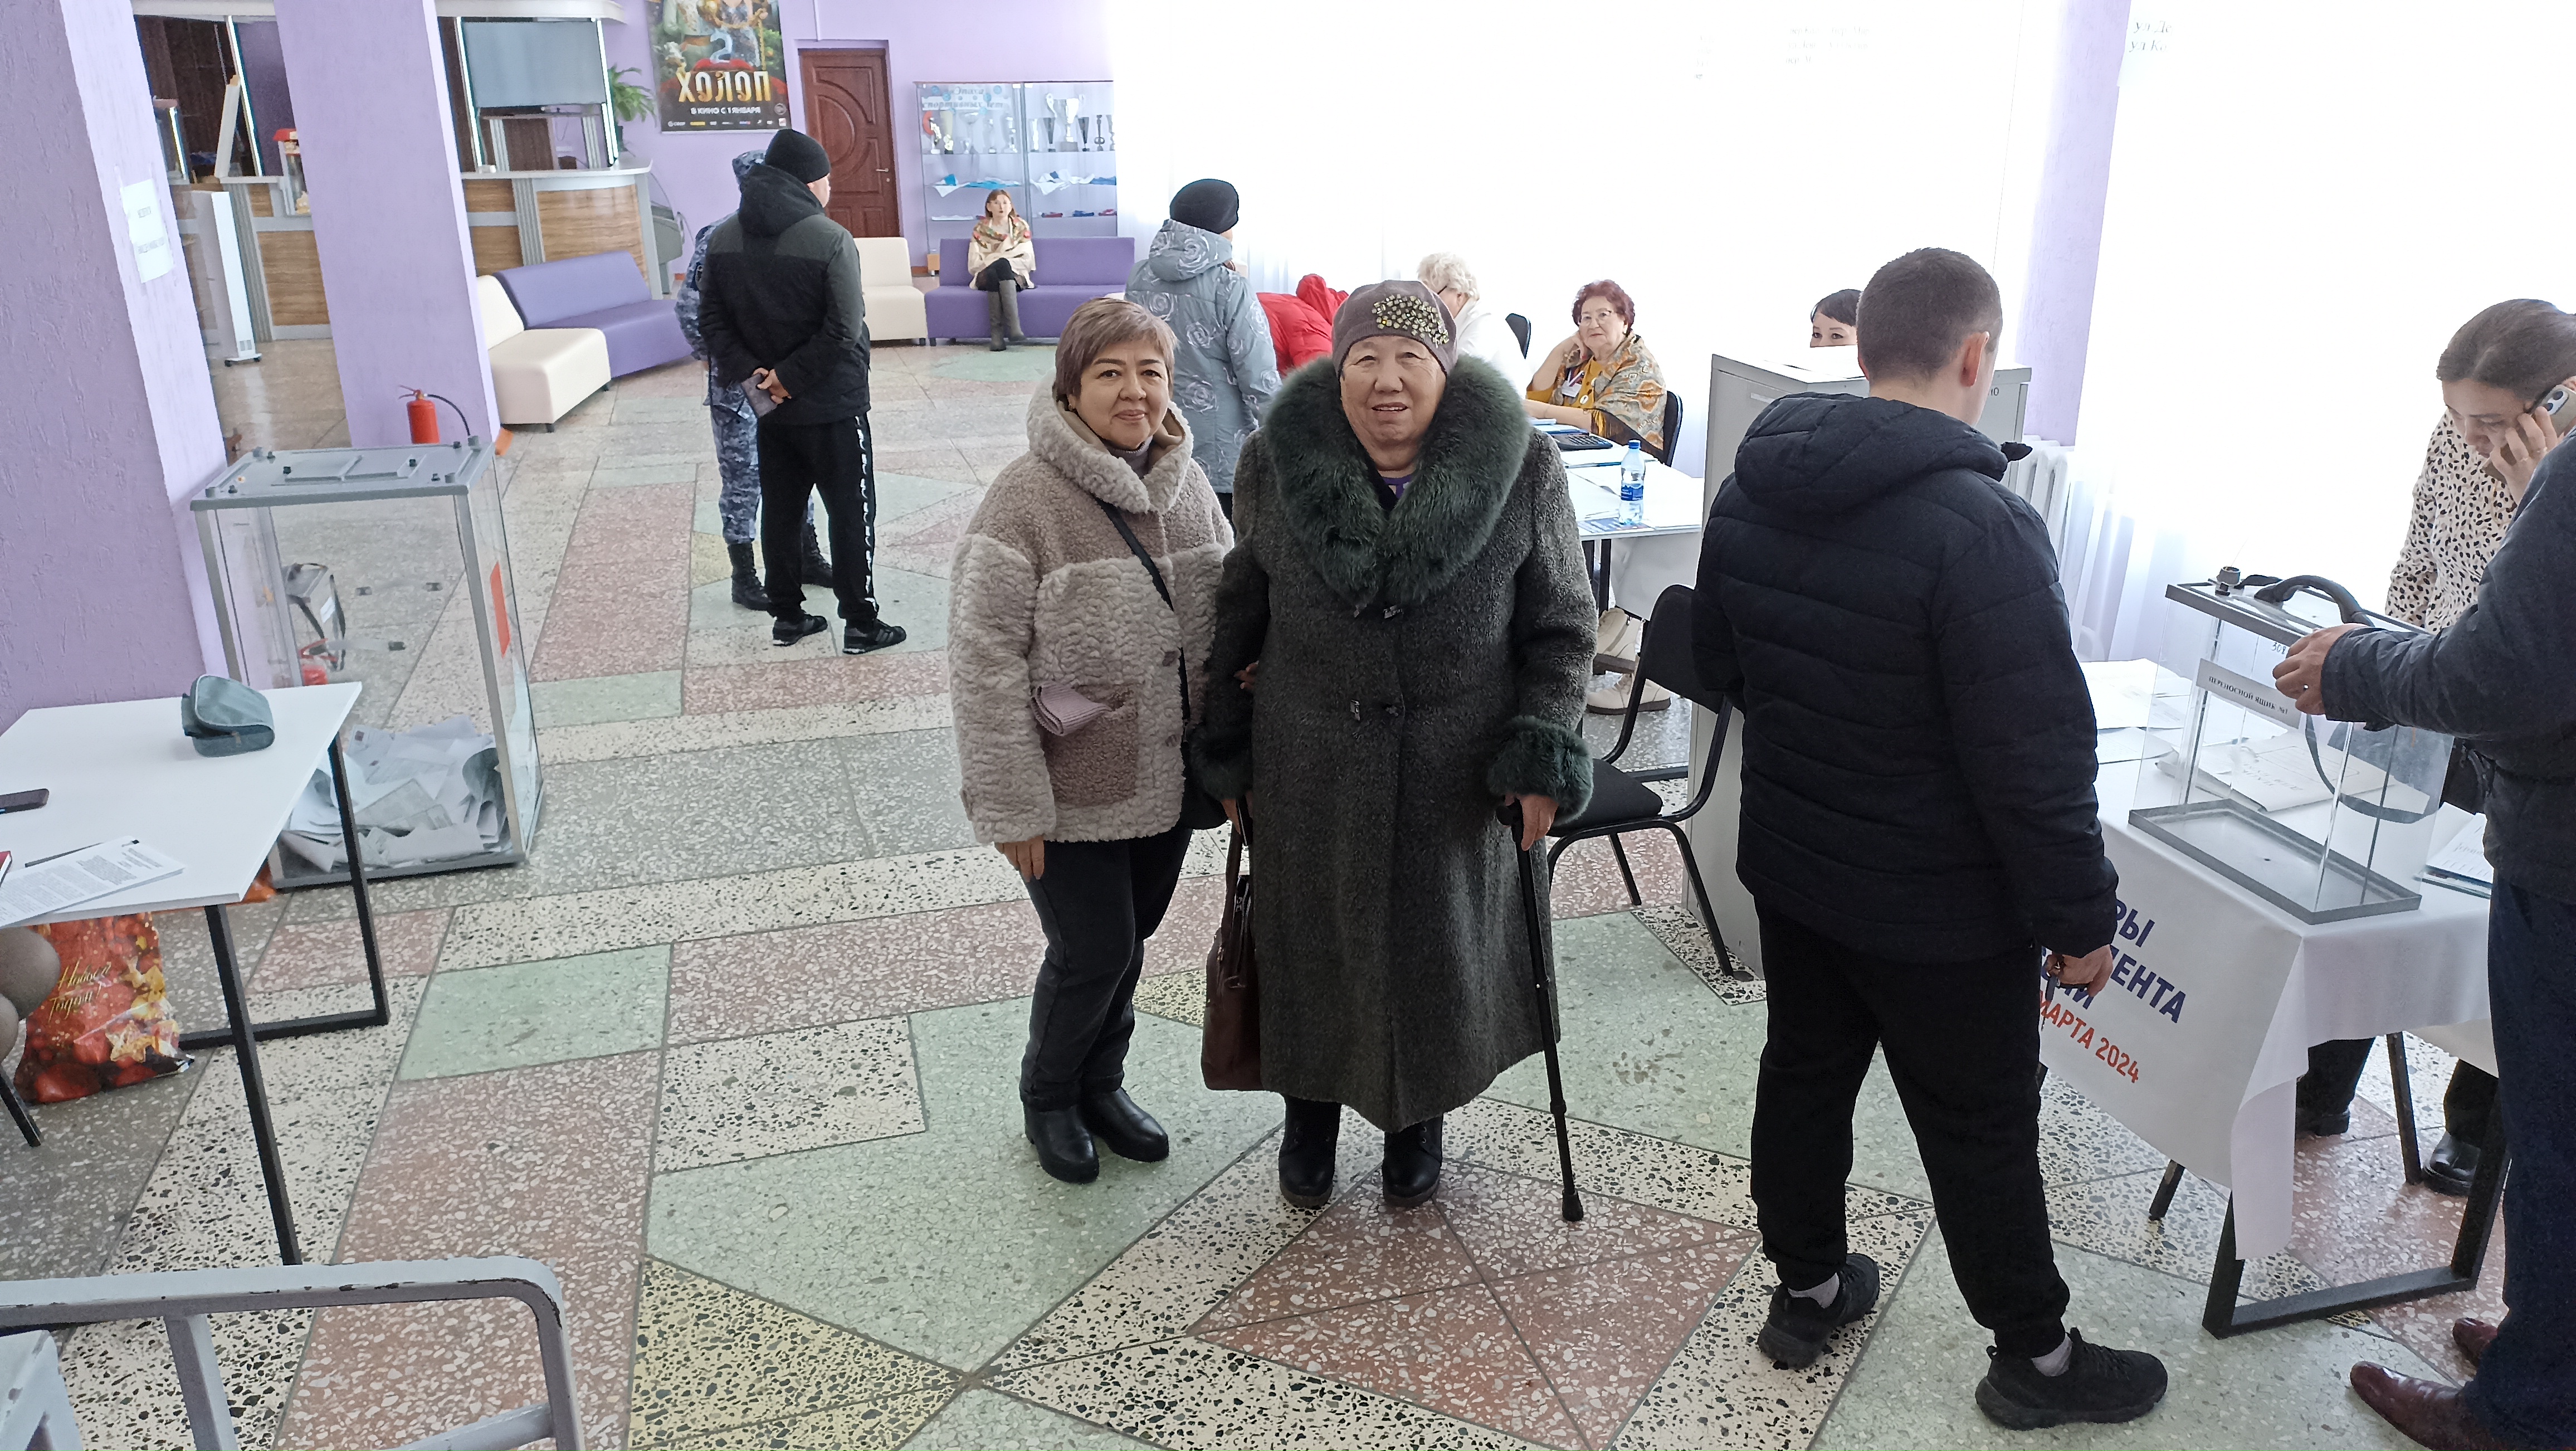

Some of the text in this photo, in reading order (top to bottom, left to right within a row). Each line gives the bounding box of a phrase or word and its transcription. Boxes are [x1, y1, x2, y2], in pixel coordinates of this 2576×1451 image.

[710, 30, 733, 64] 2
[676, 71, 771, 103] ХОЛОП
[2209, 676, 2253, 700] ПЕРЕНОСНОЙ
[2255, 697, 2275, 710] ЯЩИК
[2116, 899, 2155, 948] РЫ
[2110, 945, 2187, 1024] ЕНТА
[2095, 1038, 2139, 1083] 2024
